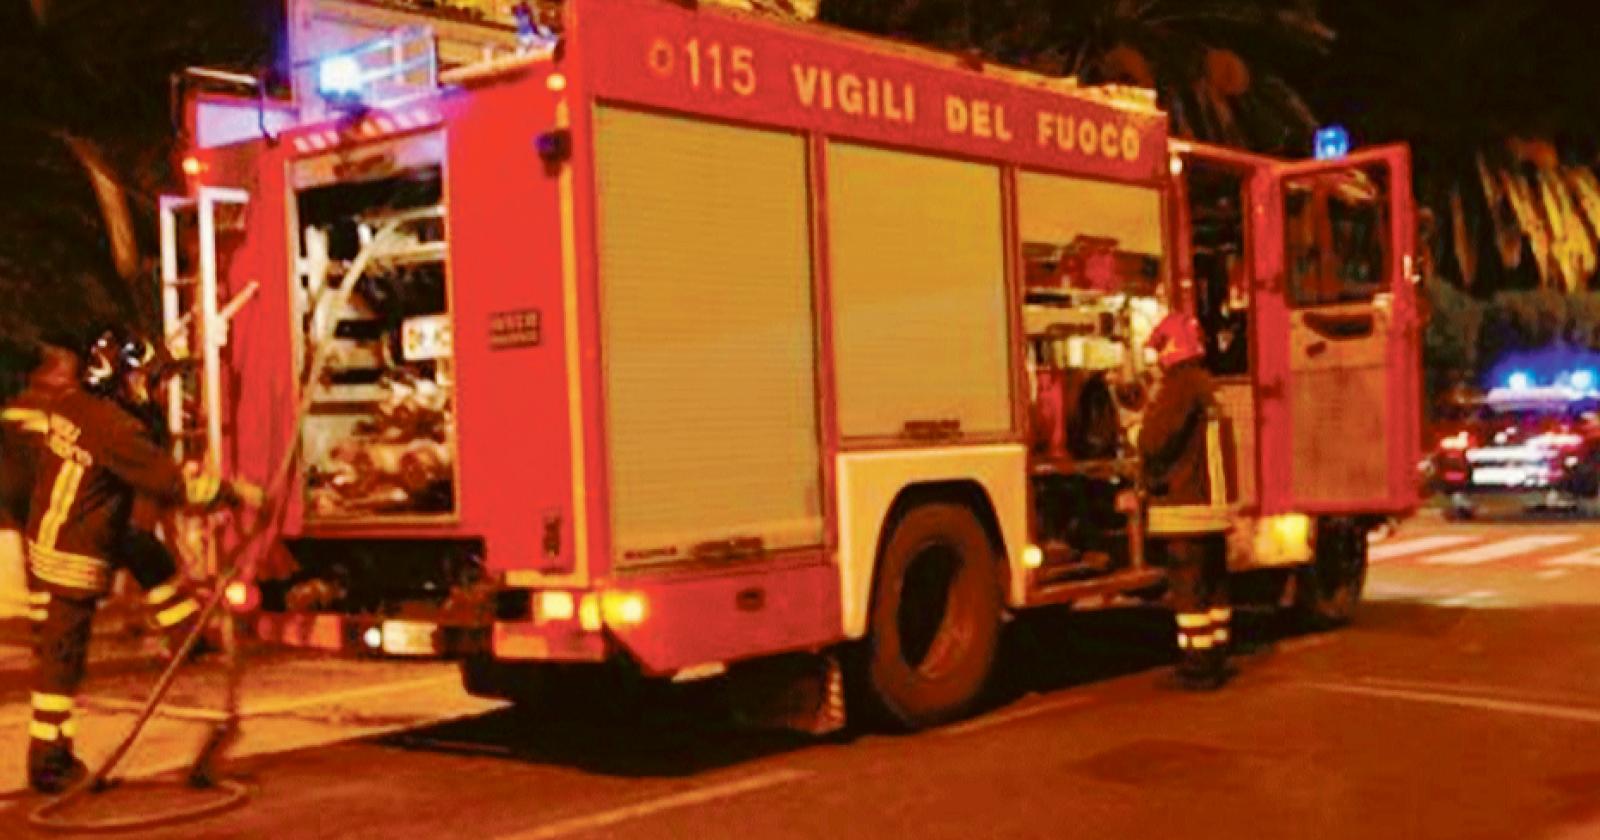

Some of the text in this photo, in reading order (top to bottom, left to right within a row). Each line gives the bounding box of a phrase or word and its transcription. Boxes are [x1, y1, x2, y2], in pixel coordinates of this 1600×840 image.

[686, 37, 1140, 161] 115 VIGILI DEL FUOCO
